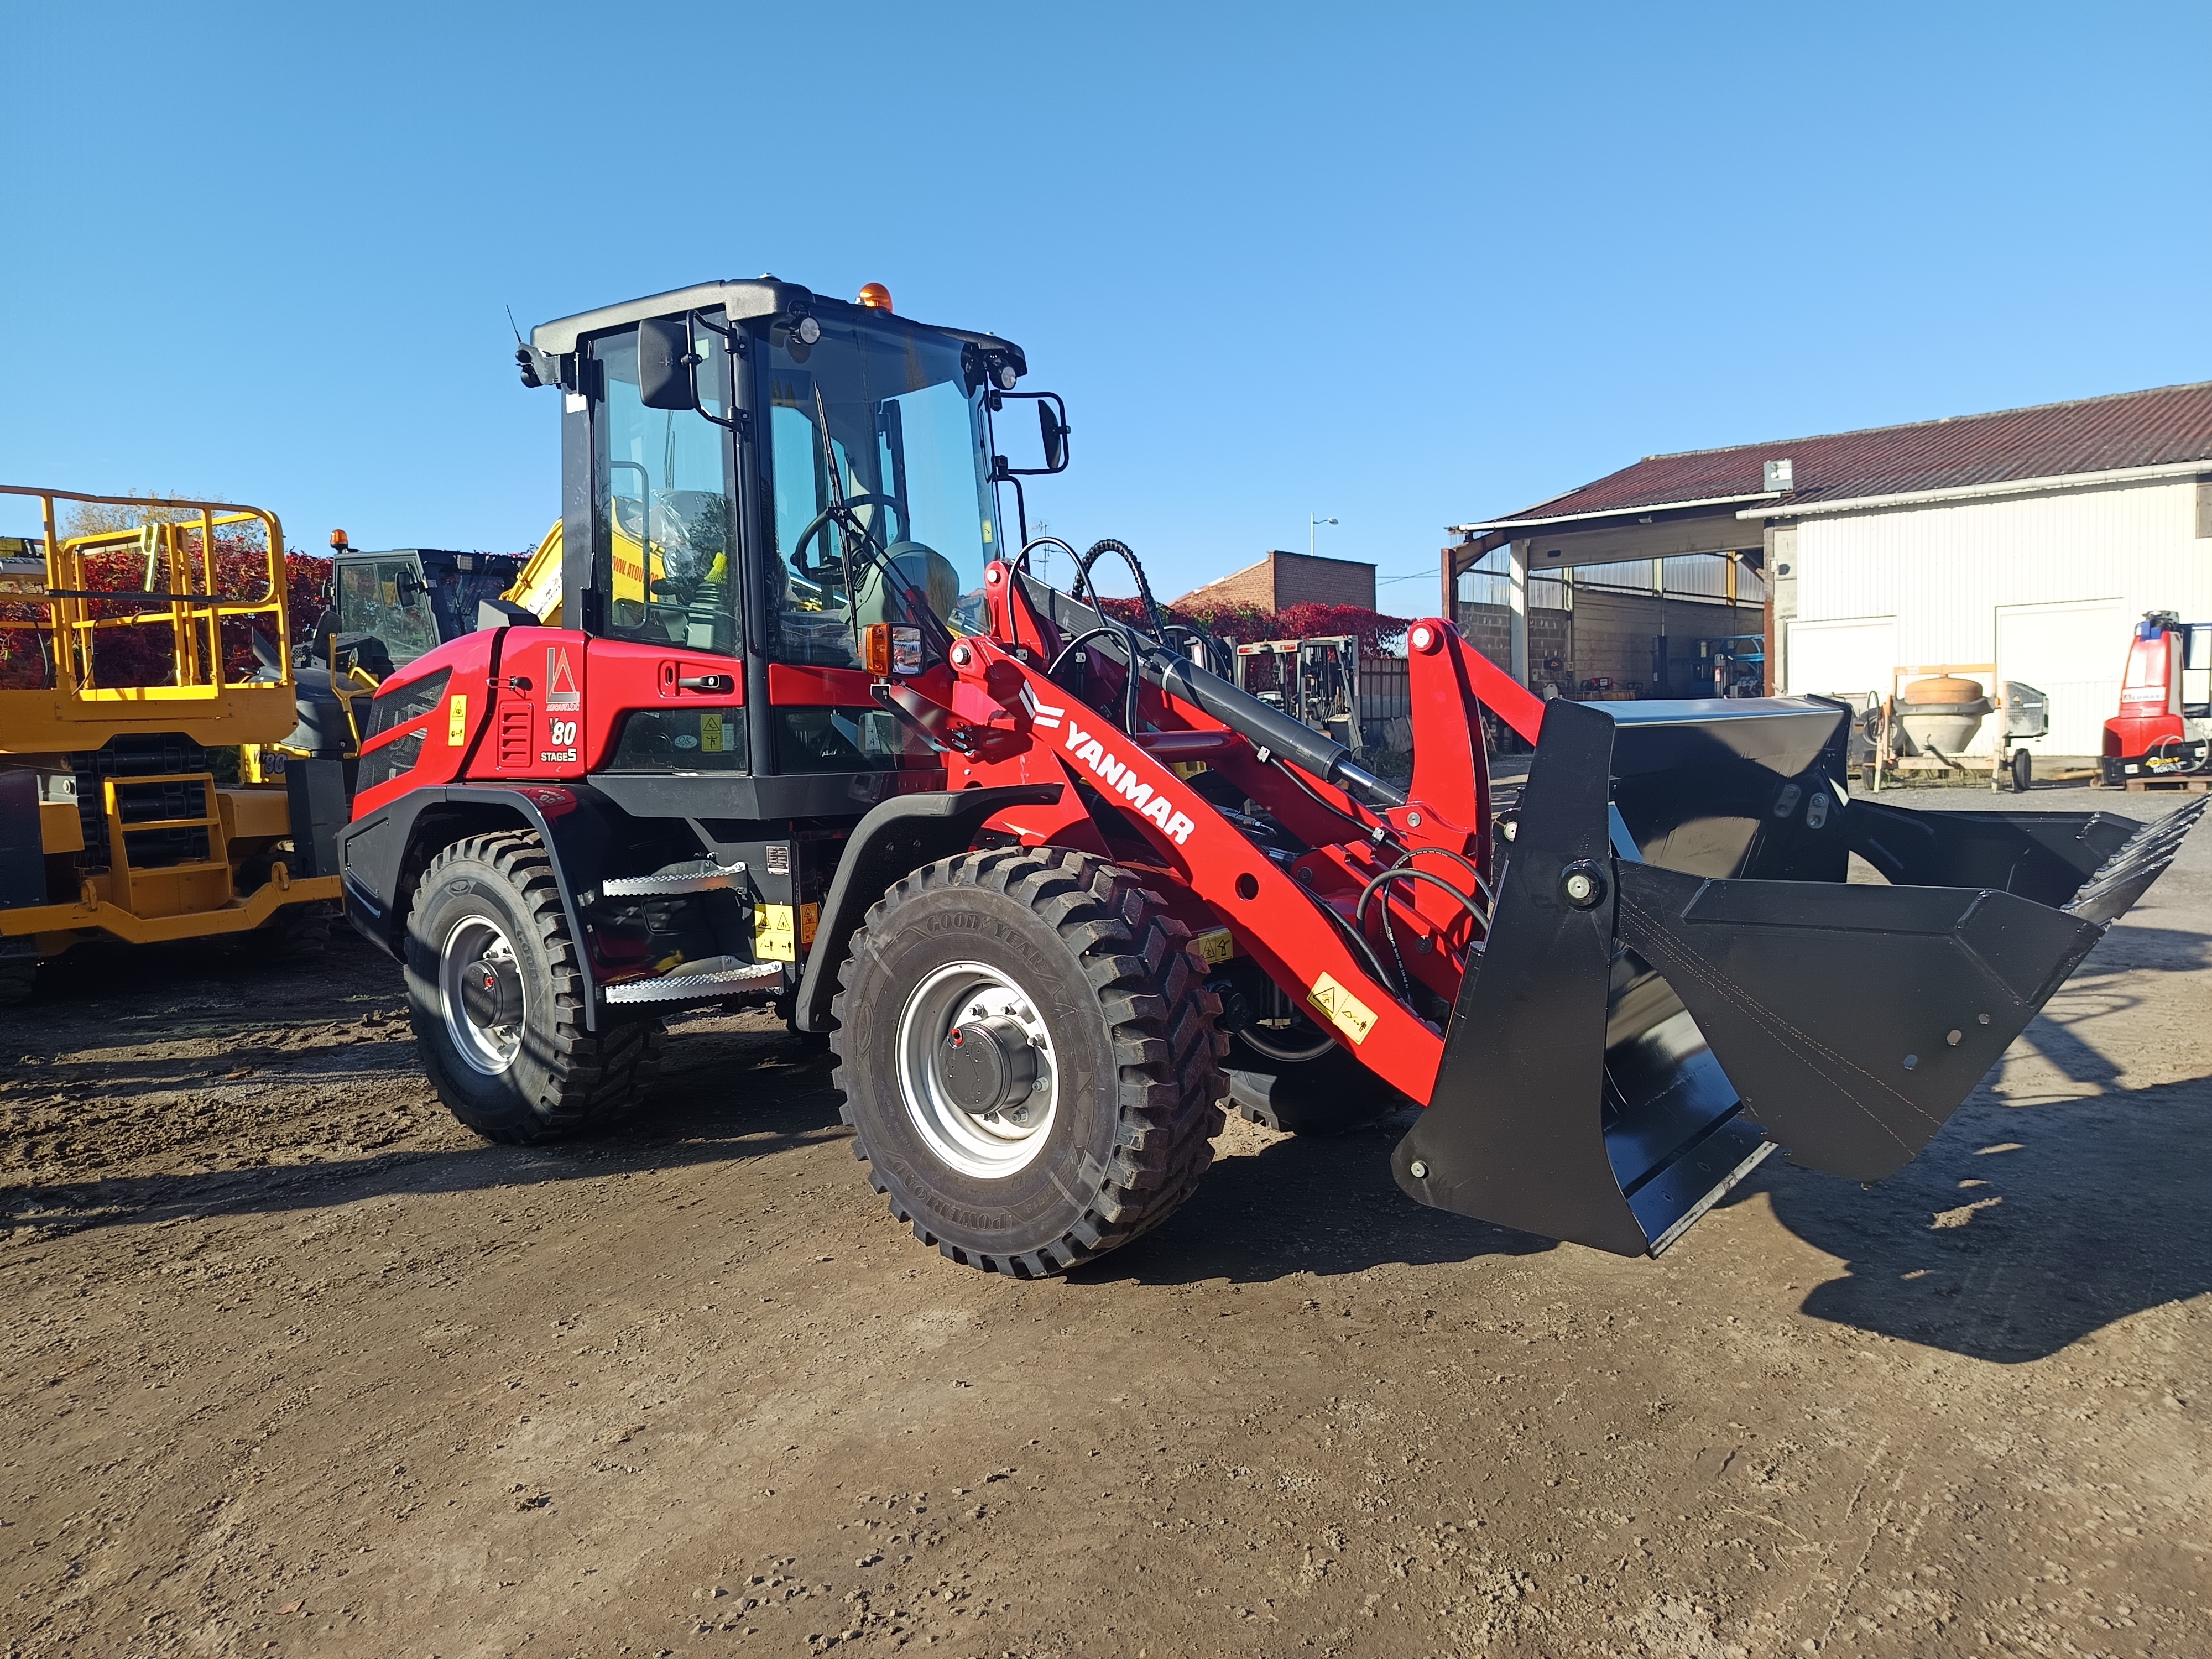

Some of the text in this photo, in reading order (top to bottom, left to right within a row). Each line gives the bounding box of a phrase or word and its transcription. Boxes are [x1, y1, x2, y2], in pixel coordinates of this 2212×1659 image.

[546, 703, 580, 711] ATOUTLOC
[1065, 720, 1195, 845] YANMAR
[892, 1160, 1007, 1231] POWERLOAD
